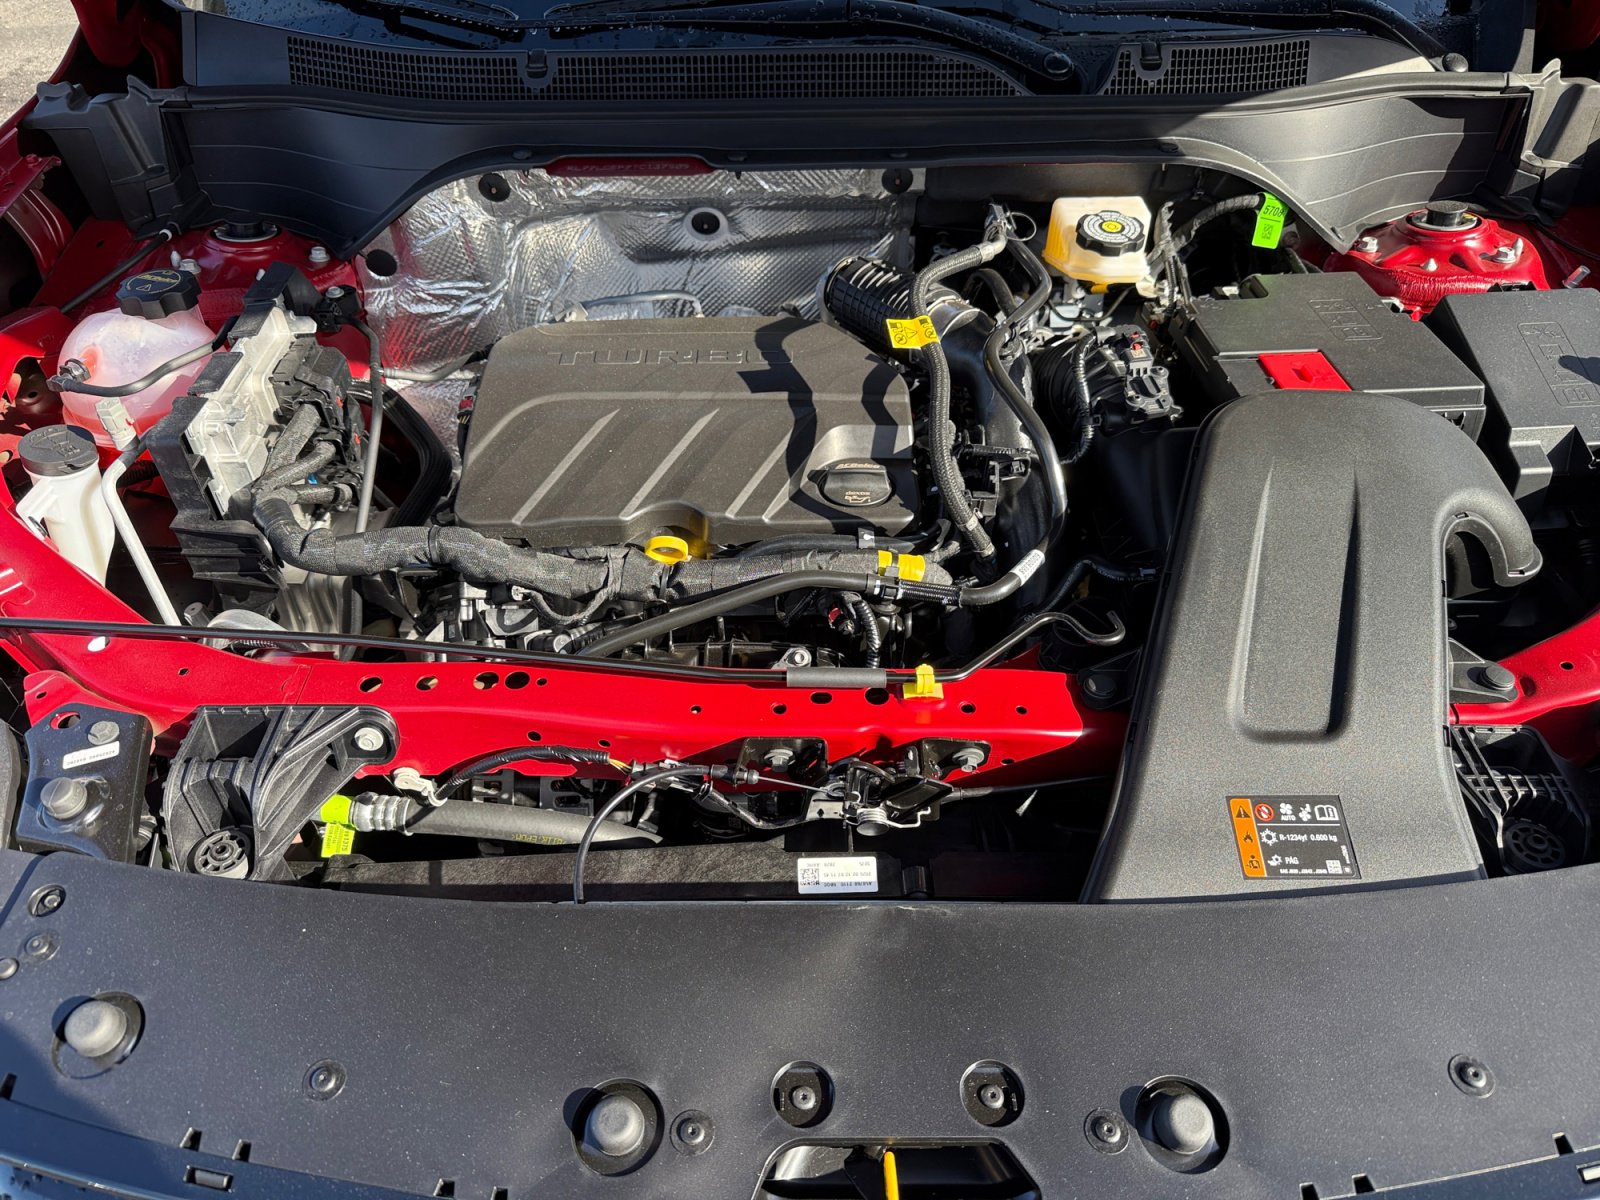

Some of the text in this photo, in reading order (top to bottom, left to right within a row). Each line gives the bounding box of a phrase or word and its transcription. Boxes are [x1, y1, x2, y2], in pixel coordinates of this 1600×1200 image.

[547, 350, 793, 366] TURBO
[1279, 834, 1307, 842] R-1234yf
[1328, 834, 1338, 842] kg
